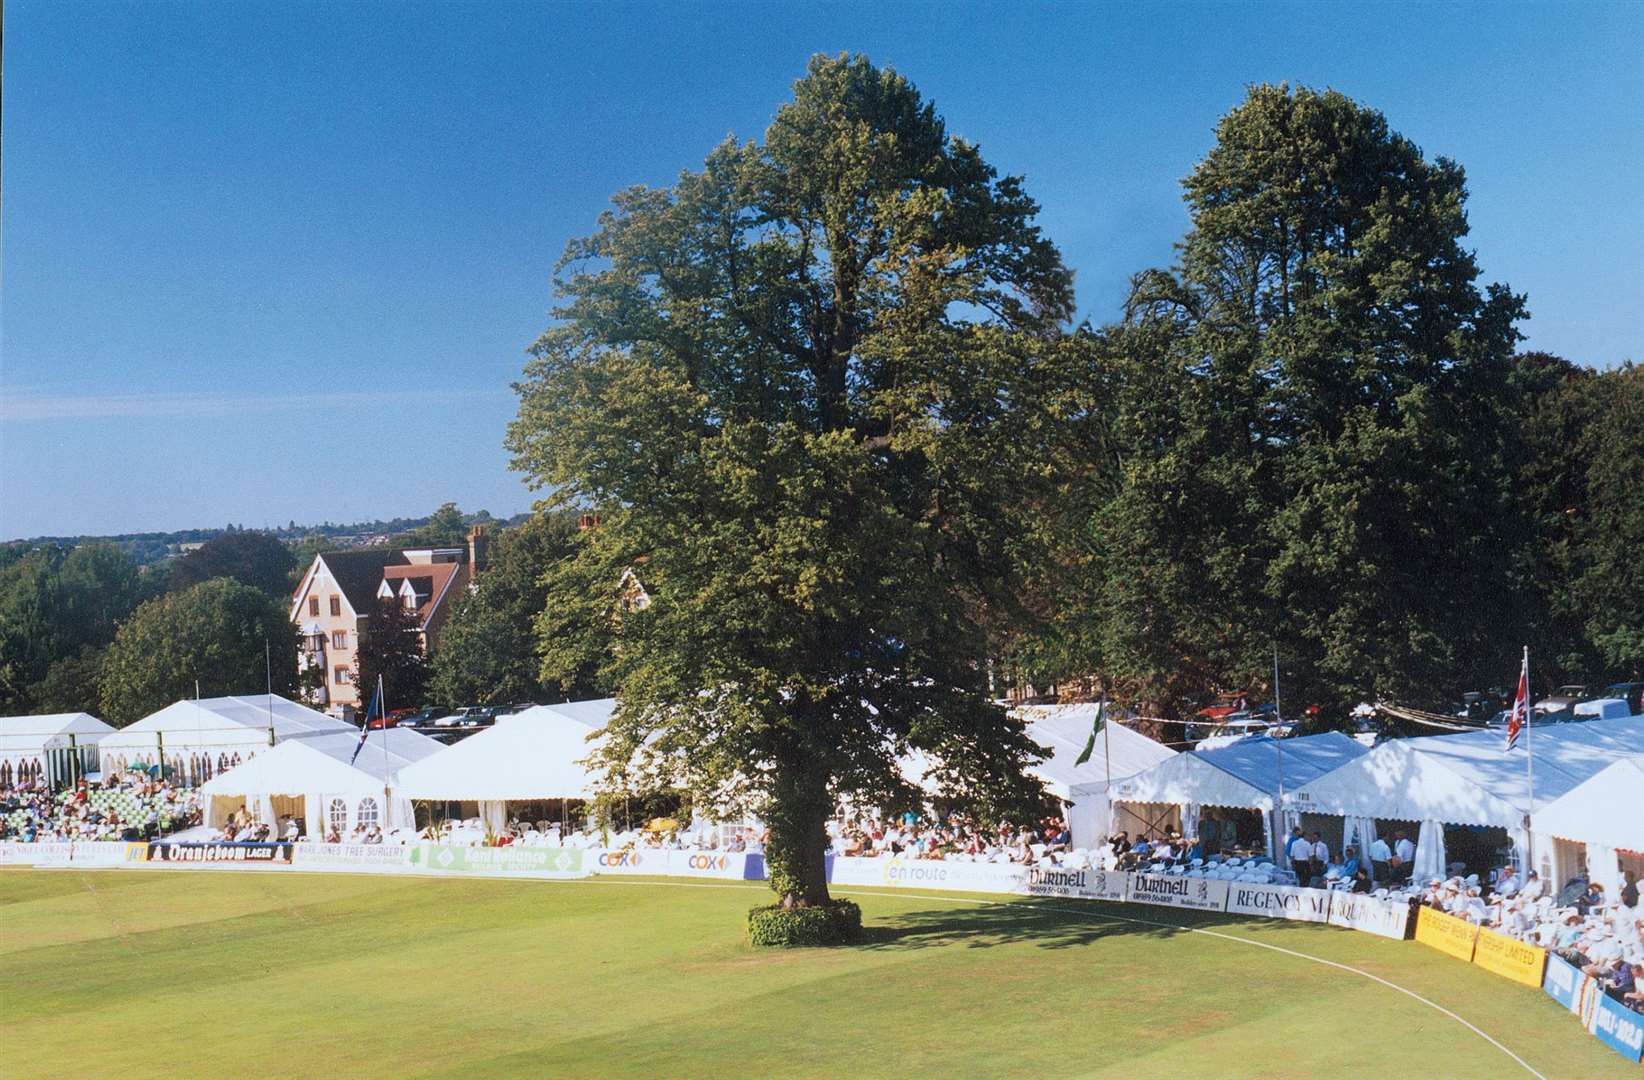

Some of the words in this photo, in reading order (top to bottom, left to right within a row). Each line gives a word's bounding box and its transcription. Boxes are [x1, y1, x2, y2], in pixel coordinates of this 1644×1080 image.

[169, 844, 246, 864] Oranjeboom
[247, 848, 272, 859] LAGER
[345, 846, 364, 857] TREE
[367, 846, 405, 858] SURGERY
[599, 853, 629, 867] COX
[688, 855, 717, 870] COX
[888, 867, 907, 880] en
[910, 868, 948, 881] route
[1135, 875, 1189, 896] Durtnell
[1236, 889, 1301, 912] REGENCY
[1505, 943, 1536, 966] LIMITED
